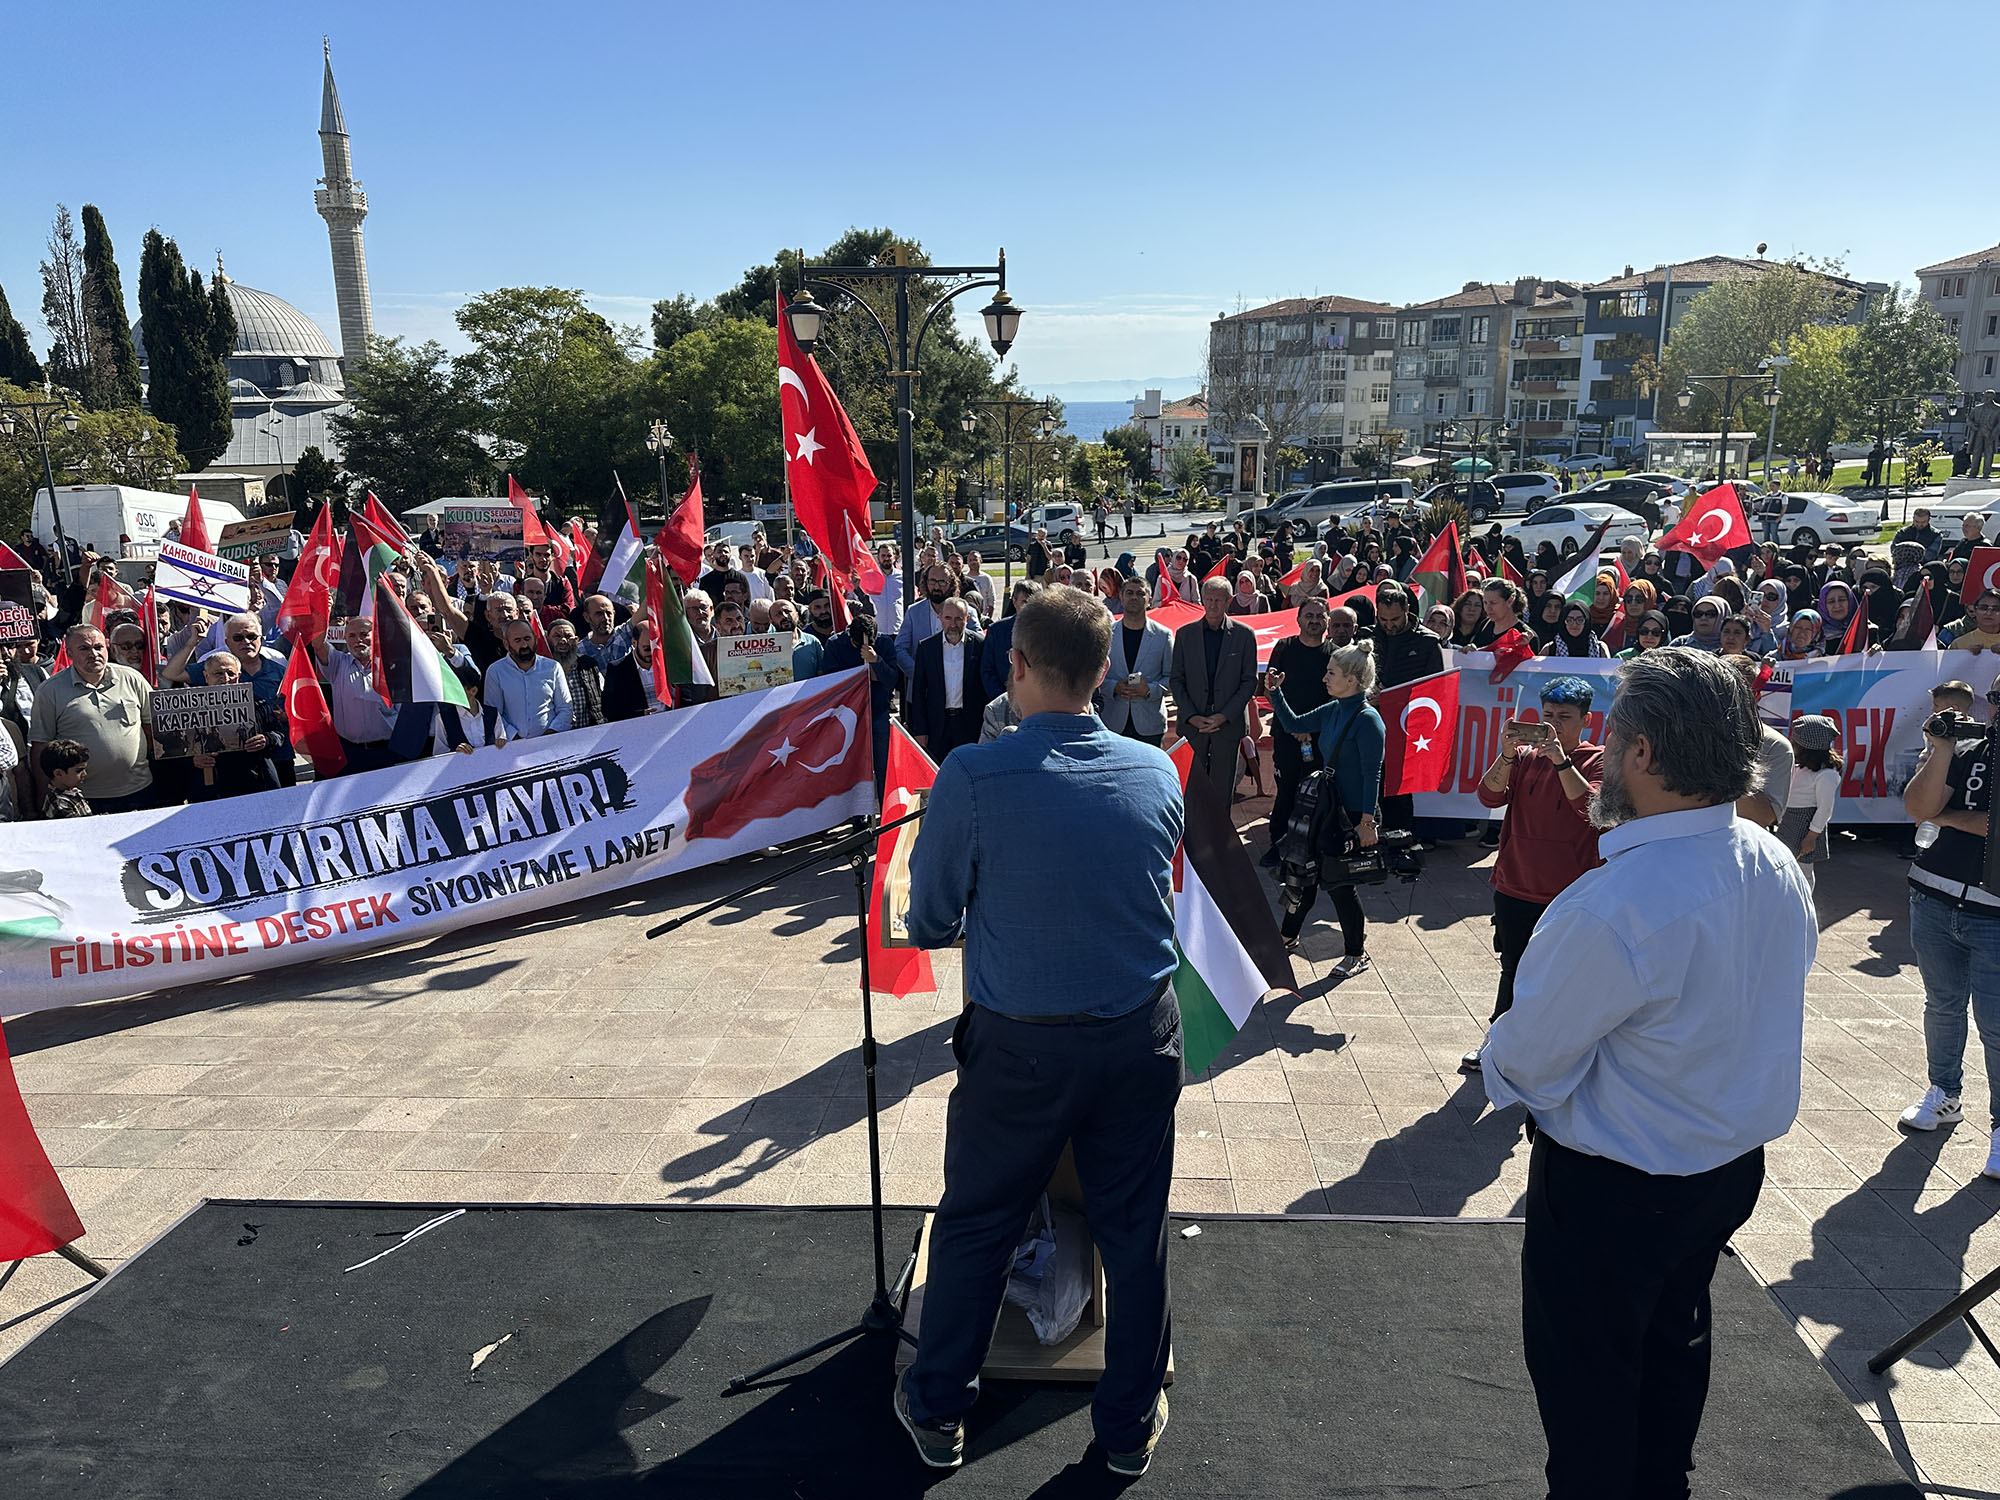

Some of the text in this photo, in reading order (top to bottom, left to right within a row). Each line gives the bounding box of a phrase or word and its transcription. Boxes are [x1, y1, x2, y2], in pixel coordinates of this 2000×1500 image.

[446, 508, 490, 523] KUDÜS
[162, 543, 247, 579] KAHROLSUN İSRAİL
[218, 543, 258, 560] KUDÜS
[154, 687, 250, 711] SİYONİST ELÇİLİK
[158, 706, 249, 732] KAPATILSIN
[1965, 762, 1987, 810] POL
[137, 768, 613, 909] SOYKIRIMA HAYIR!
[50, 824, 675, 978] FİLİSTİNE DESTEK SİYONİZME LANET
